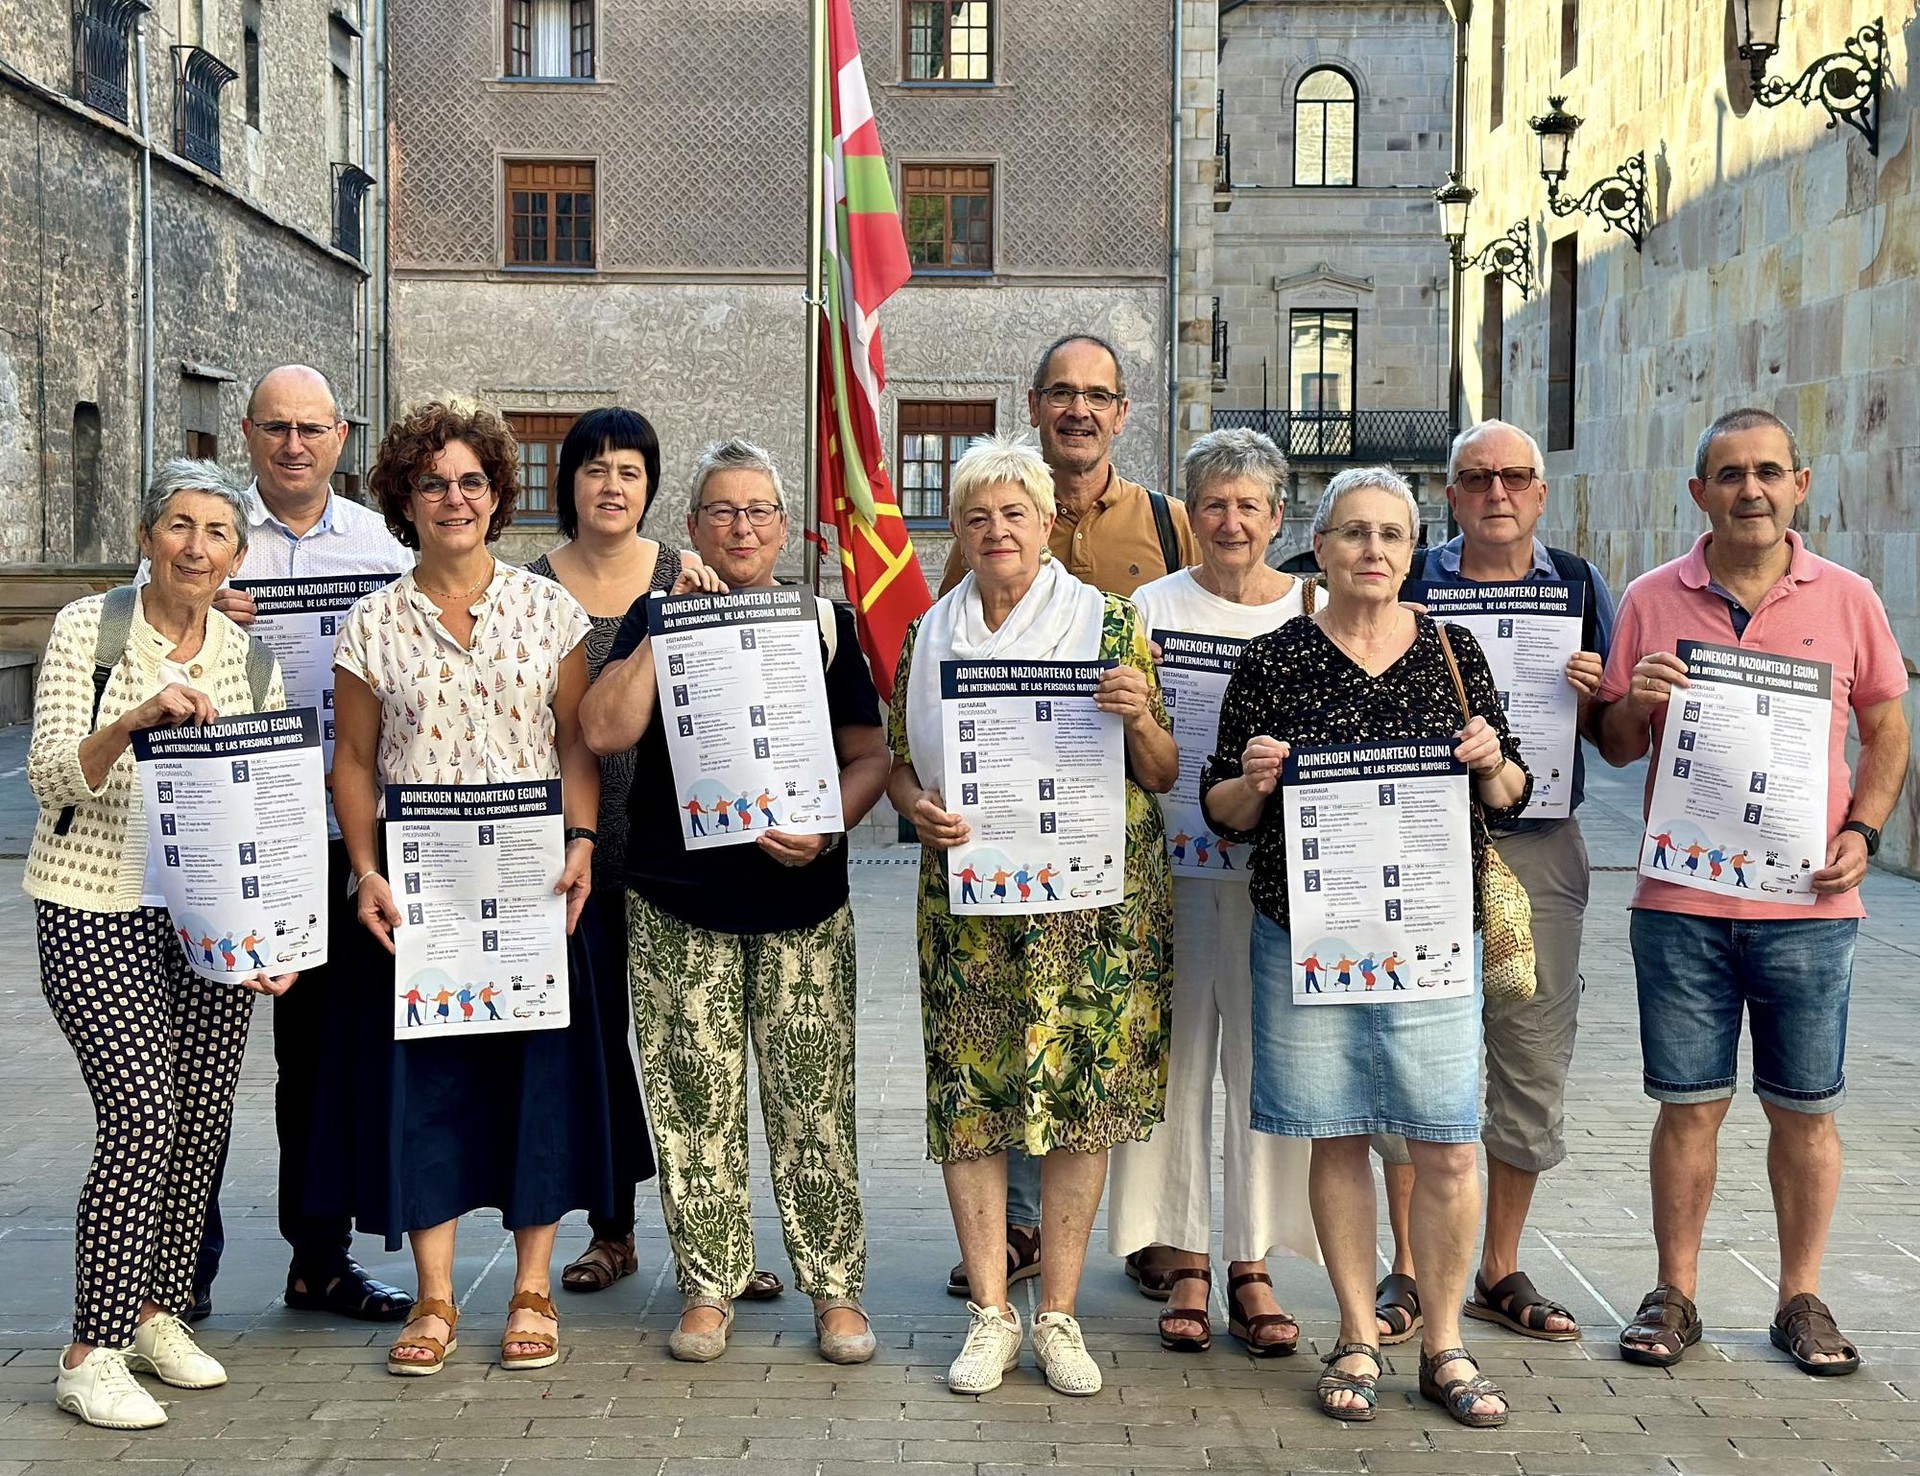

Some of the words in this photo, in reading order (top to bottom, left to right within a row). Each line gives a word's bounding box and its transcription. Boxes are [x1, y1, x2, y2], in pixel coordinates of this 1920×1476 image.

[245, 586, 295, 598] ADINEKOEN
[298, 582, 356, 595] NAZIOARTEKO
[1427, 588, 1476, 599] ADINEKOEN
[1479, 587, 1537, 598] NAZIOARTEKO
[1540, 586, 1568, 598] EGUNA
[258, 601, 303, 610] INTERNACIONAL
[317, 599, 327, 607] LAS
[662, 599, 711, 615] ADINEKOEN
[713, 593, 771, 608] NAZIOARTEKO
[774, 591, 800, 603] EGUNA
[1439, 603, 1483, 611] INTERNACIONAL
[1487, 602, 1494, 610] DE
[1496, 602, 1506, 610] LAS
[1508, 602, 1538, 610] PERSONAS
[1540, 603, 1567, 611] MAYORES
[664, 619, 674, 628] DÍA
[676, 614, 722, 626] INTERNACIONAL
[725, 612, 733, 620] DE
[734, 611, 745, 619] LAS
[746, 609, 775, 618] PERSONAS
[776, 608, 801, 616] MAYORES
[325, 624, 331, 634] 3
[1501, 626, 1509, 637] 3
[745, 638, 752, 648] 3
[1164, 637, 1214, 654] ADINEKOEN
[1164, 654, 1174, 663] DÍA
[1176, 655, 1220, 668] INTERNACIONAL
[1224, 660, 1231, 669] DE
[1690, 649, 1737, 666] ADINEKOEN
[1739, 656, 1791, 675] NAZIOARTEKO
[1793, 665, 1819, 680] EGUNA
[671, 663, 683, 674] 30
[956, 667, 1008, 679] ADINEKOEN
[1011, 667, 1072, 679] NAZIOARTEKO
[1690, 665, 1701, 674] DÍA
[1702, 667, 1744, 681] INTERNACIONAL
[1746, 673, 1754, 681] DE
[1754, 674, 1764, 683] LAS
[1765, 676, 1792, 689] PERSONAS
[1793, 681, 1818, 692] MAYORES
[958, 683, 968, 692] DÍA
[970, 683, 1018, 692] INTERNACIONAL
[1044, 683, 1075, 691] PERSONAS
[327, 697, 334, 706] 4
[678, 694, 684, 704] 1
[1163, 695, 1175, 706] 30
[1040, 709, 1047, 720] 3
[1760, 704, 1766, 714] 3
[755, 715, 762, 725] 4
[1685, 709, 1698, 721] 30
[149, 727, 202, 742] ADINEKOEN
[204, 721, 269, 737] NAZIOARTEKO
[271, 716, 303, 731] EGUNA
[329, 729, 334, 738] 5
[683, 725, 690, 735] 2
[961, 729, 974, 740] 30
[152, 744, 164, 754] DÍA
[165, 743, 212, 753] INTERNACIONAL
[215, 742, 224, 751] DE
[226, 741, 239, 750] LAS
[240, 737, 272, 749] PERSONAS
[274, 734, 303, 745] MAYORES
[1684, 738, 1689, 748] 1
[759, 747, 765, 757] 5
[1298, 753, 1350, 767] ADINEKOEN
[1354, 748, 1416, 763] NAZIOARTEKO
[1420, 745, 1451, 758] EGUNA
[965, 760, 971, 771] 1
[1300, 770, 1310, 779] DÍA
[1312, 767, 1360, 779] INTERNACIONAL
[1364, 766, 1372, 774] DE
[1374, 765, 1386, 774] LAS
[1387, 763, 1419, 773] PERSONAS
[1421, 762, 1450, 771] MAYORES
[237, 770, 244, 781] 3
[1678, 767, 1685, 777] 2
[1754, 781, 1762, 792] 4
[160, 790, 172, 801] 30
[401, 791, 451, 803] ADINEKOEN
[454, 789, 515, 803] NAZIOARTEKO
[518, 787, 547, 799] EGUNA
[966, 793, 974, 803] 2
[1043, 787, 1050, 798] 4
[1383, 793, 1390, 804] 3
[402, 807, 413, 816] DÍA
[414, 807, 461, 816] INTERNACIONAL
[464, 807, 473, 815] DE
[474, 807, 485, 815] LAS
[487, 804, 518, 814] PERSONAS
[519, 803, 546, 812] MAYORES
[1302, 815, 1315, 826] 30
[1748, 812, 1756, 822] 5
[165, 823, 171, 834] 1
[1045, 821, 1052, 832] 5
[483, 834, 490, 844] 3
[244, 852, 252, 862] 4
[405, 851, 418, 861] 30
[1307, 848, 1313, 858] 1
[169, 854, 176, 865] 2
[1309, 879, 1316, 890] 2
[1387, 874, 1395, 885] 4
[248, 886, 254, 896] 5
[409, 882, 414, 892] 1
[412, 912, 419, 922] 2
[485, 907, 493, 917] 4
[1390, 909, 1397, 920] 5
[487, 939, 493, 949] 5
